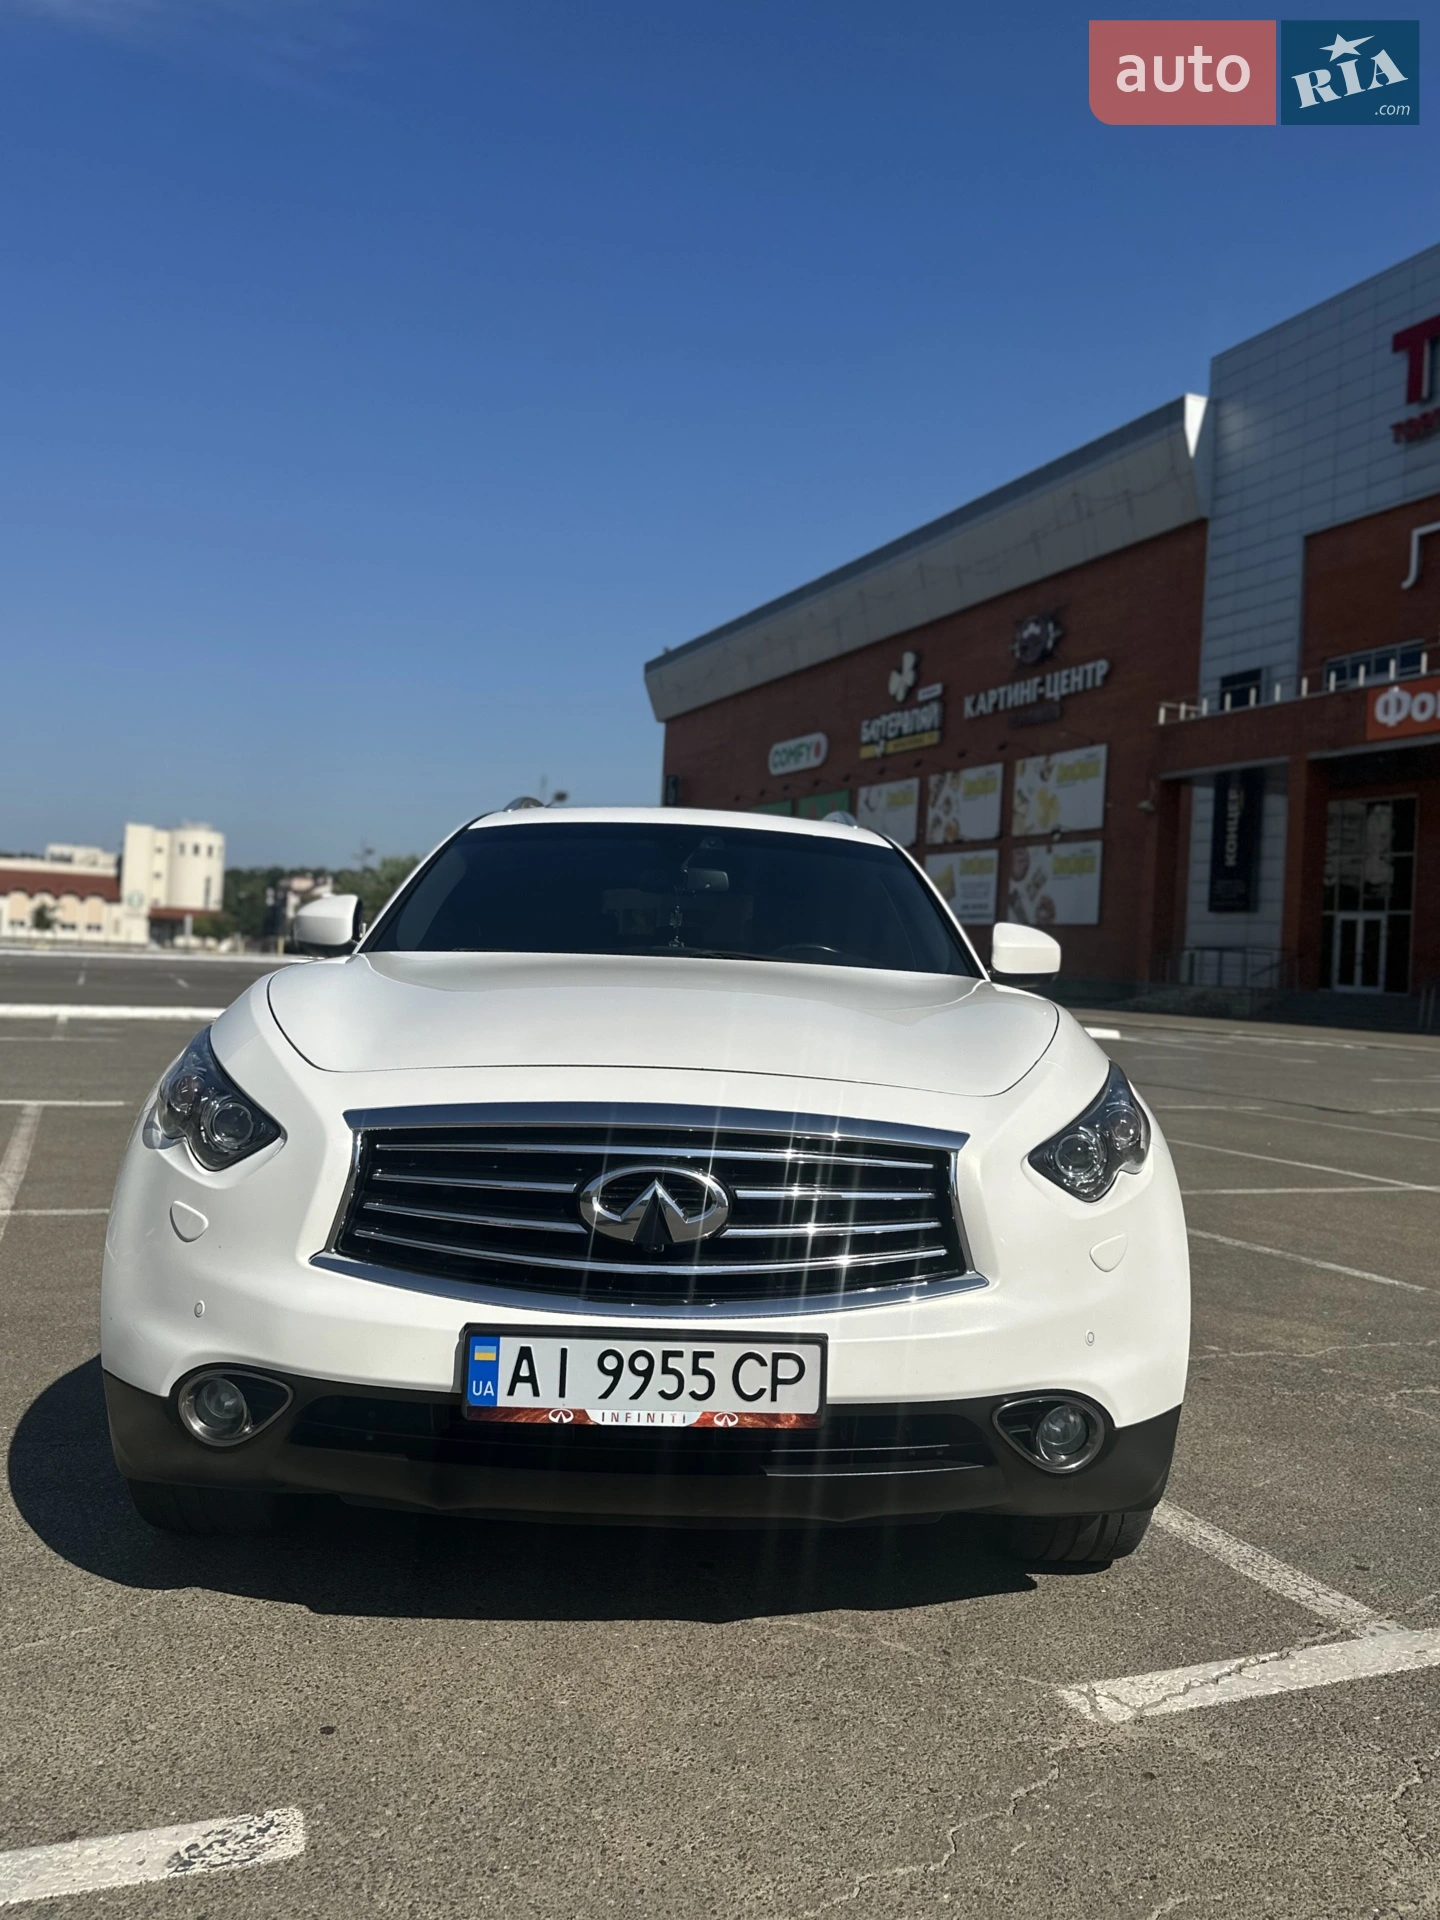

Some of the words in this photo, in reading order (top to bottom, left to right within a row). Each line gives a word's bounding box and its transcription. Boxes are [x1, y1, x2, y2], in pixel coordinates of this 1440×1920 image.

[963, 658, 1111, 719] КАРТИНГ-ЦЕНТР
[472, 1380, 495, 1397] UA
[597, 1349, 717, 1401] 9955
[601, 1412, 687, 1424] INFINITI
